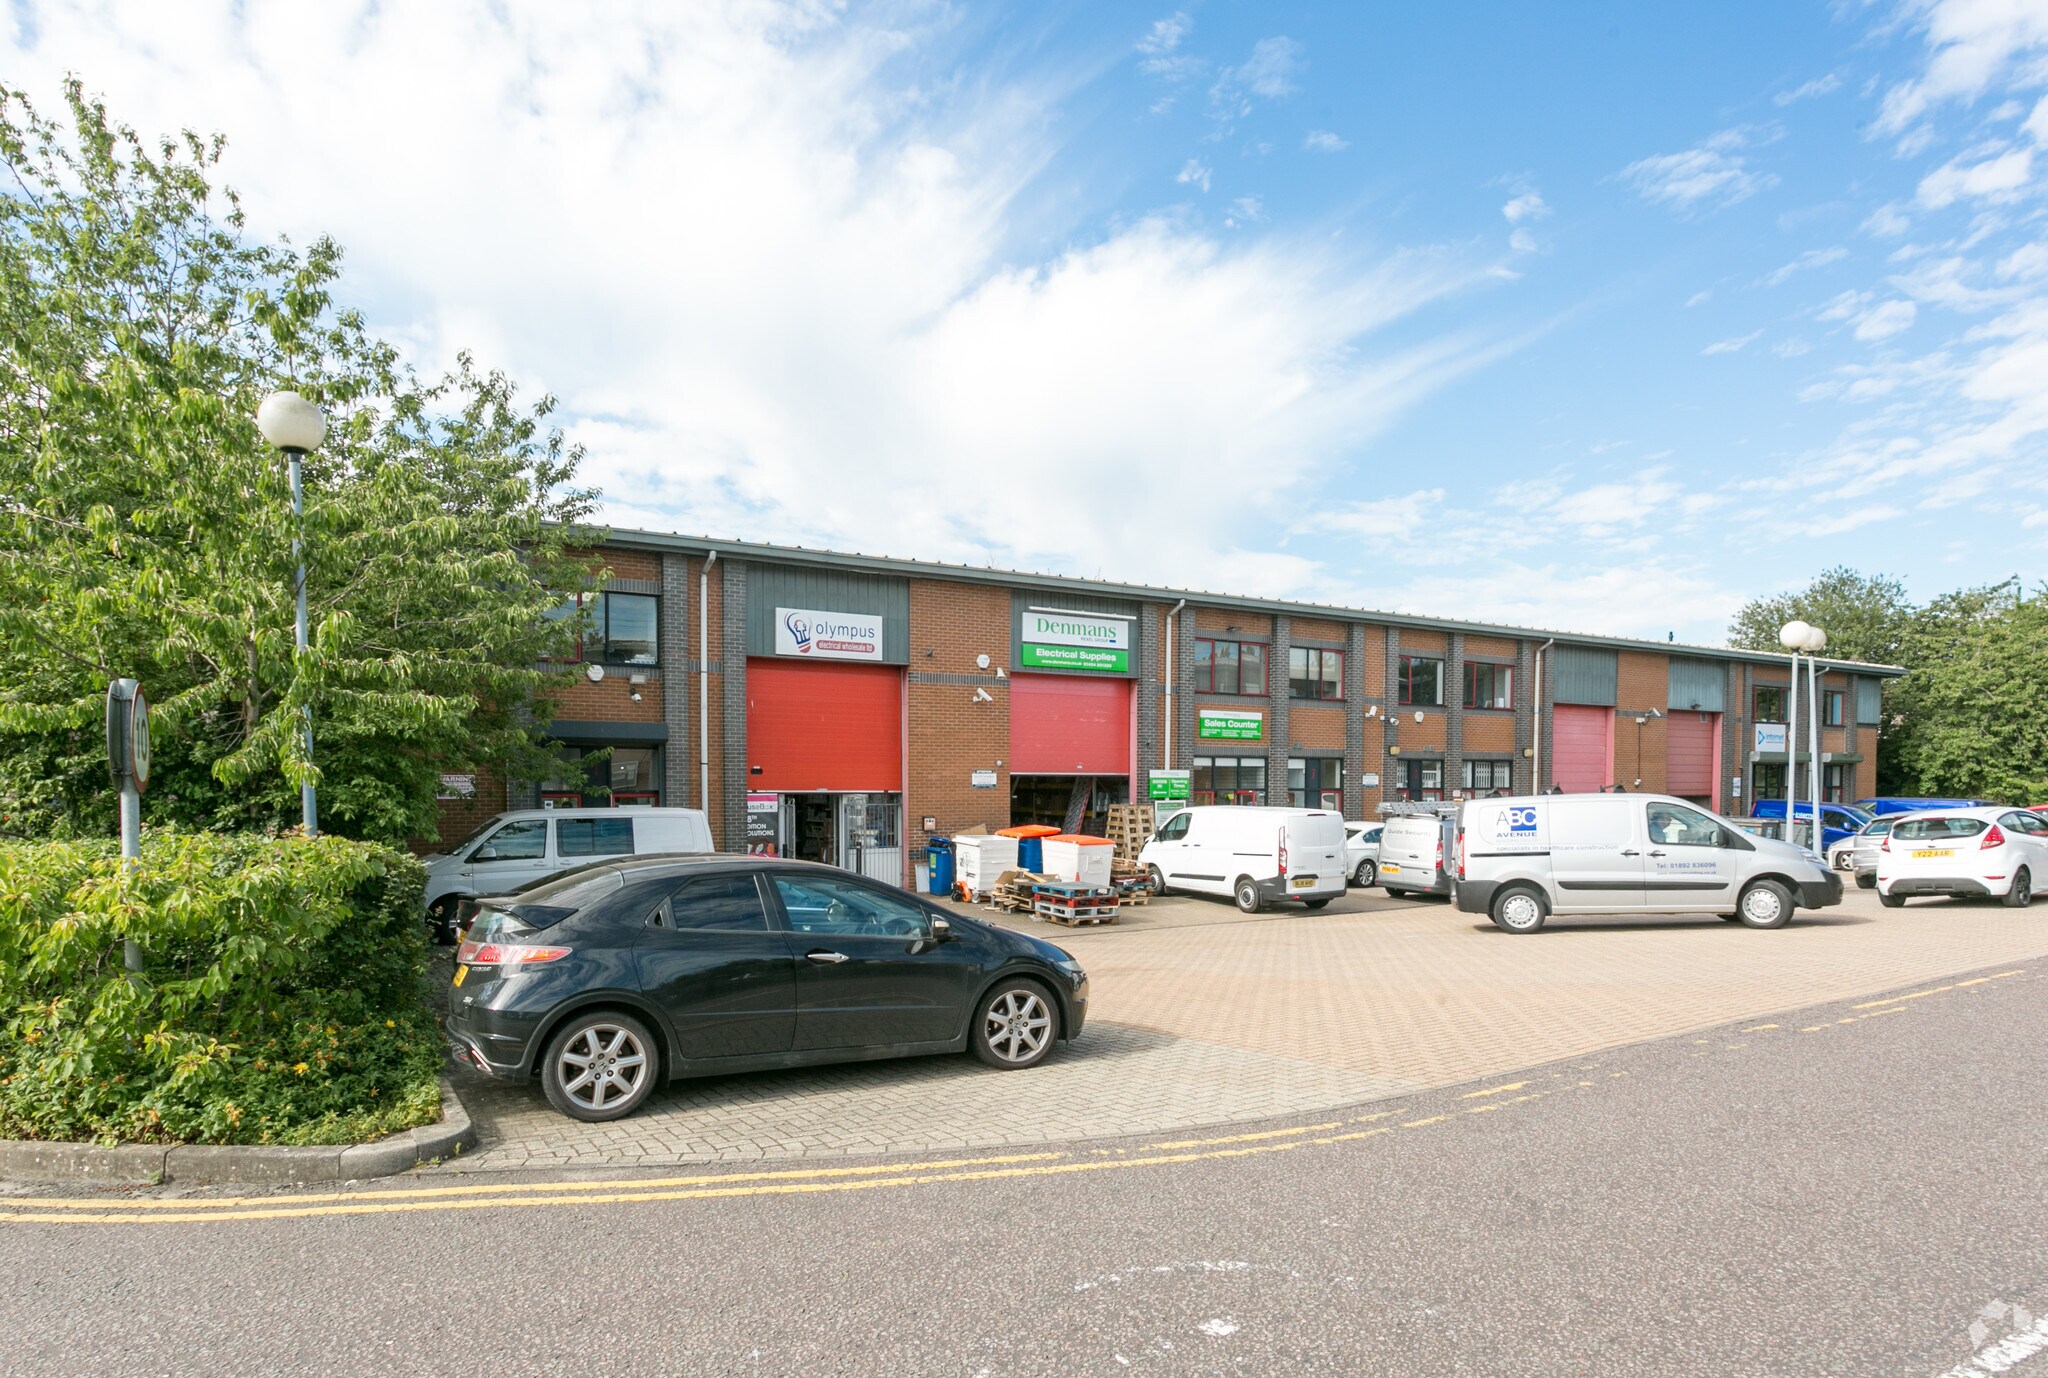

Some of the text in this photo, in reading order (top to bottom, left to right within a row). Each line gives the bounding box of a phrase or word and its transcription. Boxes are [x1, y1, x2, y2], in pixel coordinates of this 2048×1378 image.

[815, 621, 875, 639] olympus
[1037, 618, 1116, 638] Denmans
[818, 641, 841, 649] electrical
[842, 643, 866, 652] wholesale
[1036, 648, 1117, 662] Electrical Supplies
[1204, 719, 1259, 729] Sales Counter
[136, 717, 148, 761] 10
[748, 803, 773, 811] useBox
[1496, 808, 1537, 827] ABC
